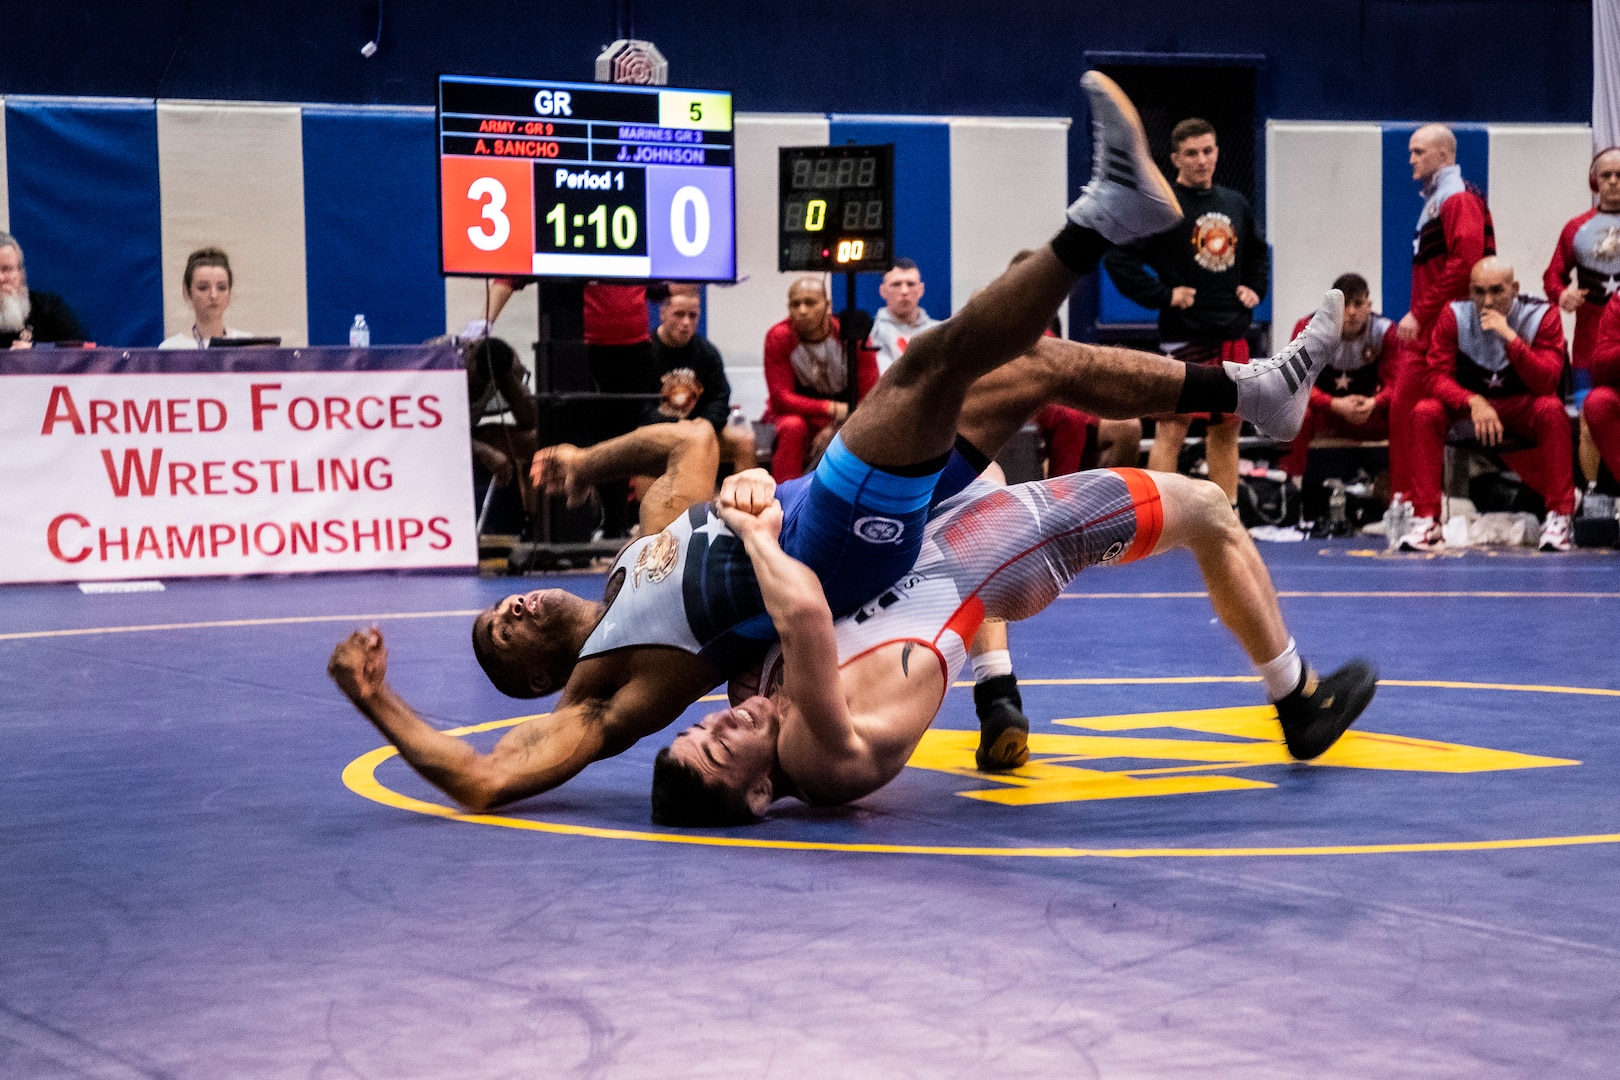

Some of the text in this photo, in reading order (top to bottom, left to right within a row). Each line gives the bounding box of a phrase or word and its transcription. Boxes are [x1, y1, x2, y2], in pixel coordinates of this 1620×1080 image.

[534, 90, 573, 116] GR
[689, 102, 702, 121] 5
[479, 119, 516, 134] ARMY
[525, 122, 544, 136] GR
[618, 126, 673, 141] MARINES
[474, 138, 560, 158] A. SANCHO
[617, 145, 705, 164] J. JOHNSON
[555, 168, 624, 190] Period 1
[467, 177, 510, 251] 3
[546, 203, 638, 250] 1:10
[670, 186, 710, 256] 0
[806, 200, 827, 231] 0
[41, 382, 444, 436] ARMED FORCES
[100, 447, 394, 498] WRESTLING
[46, 512, 453, 564] CHAMPIONSHIPS
